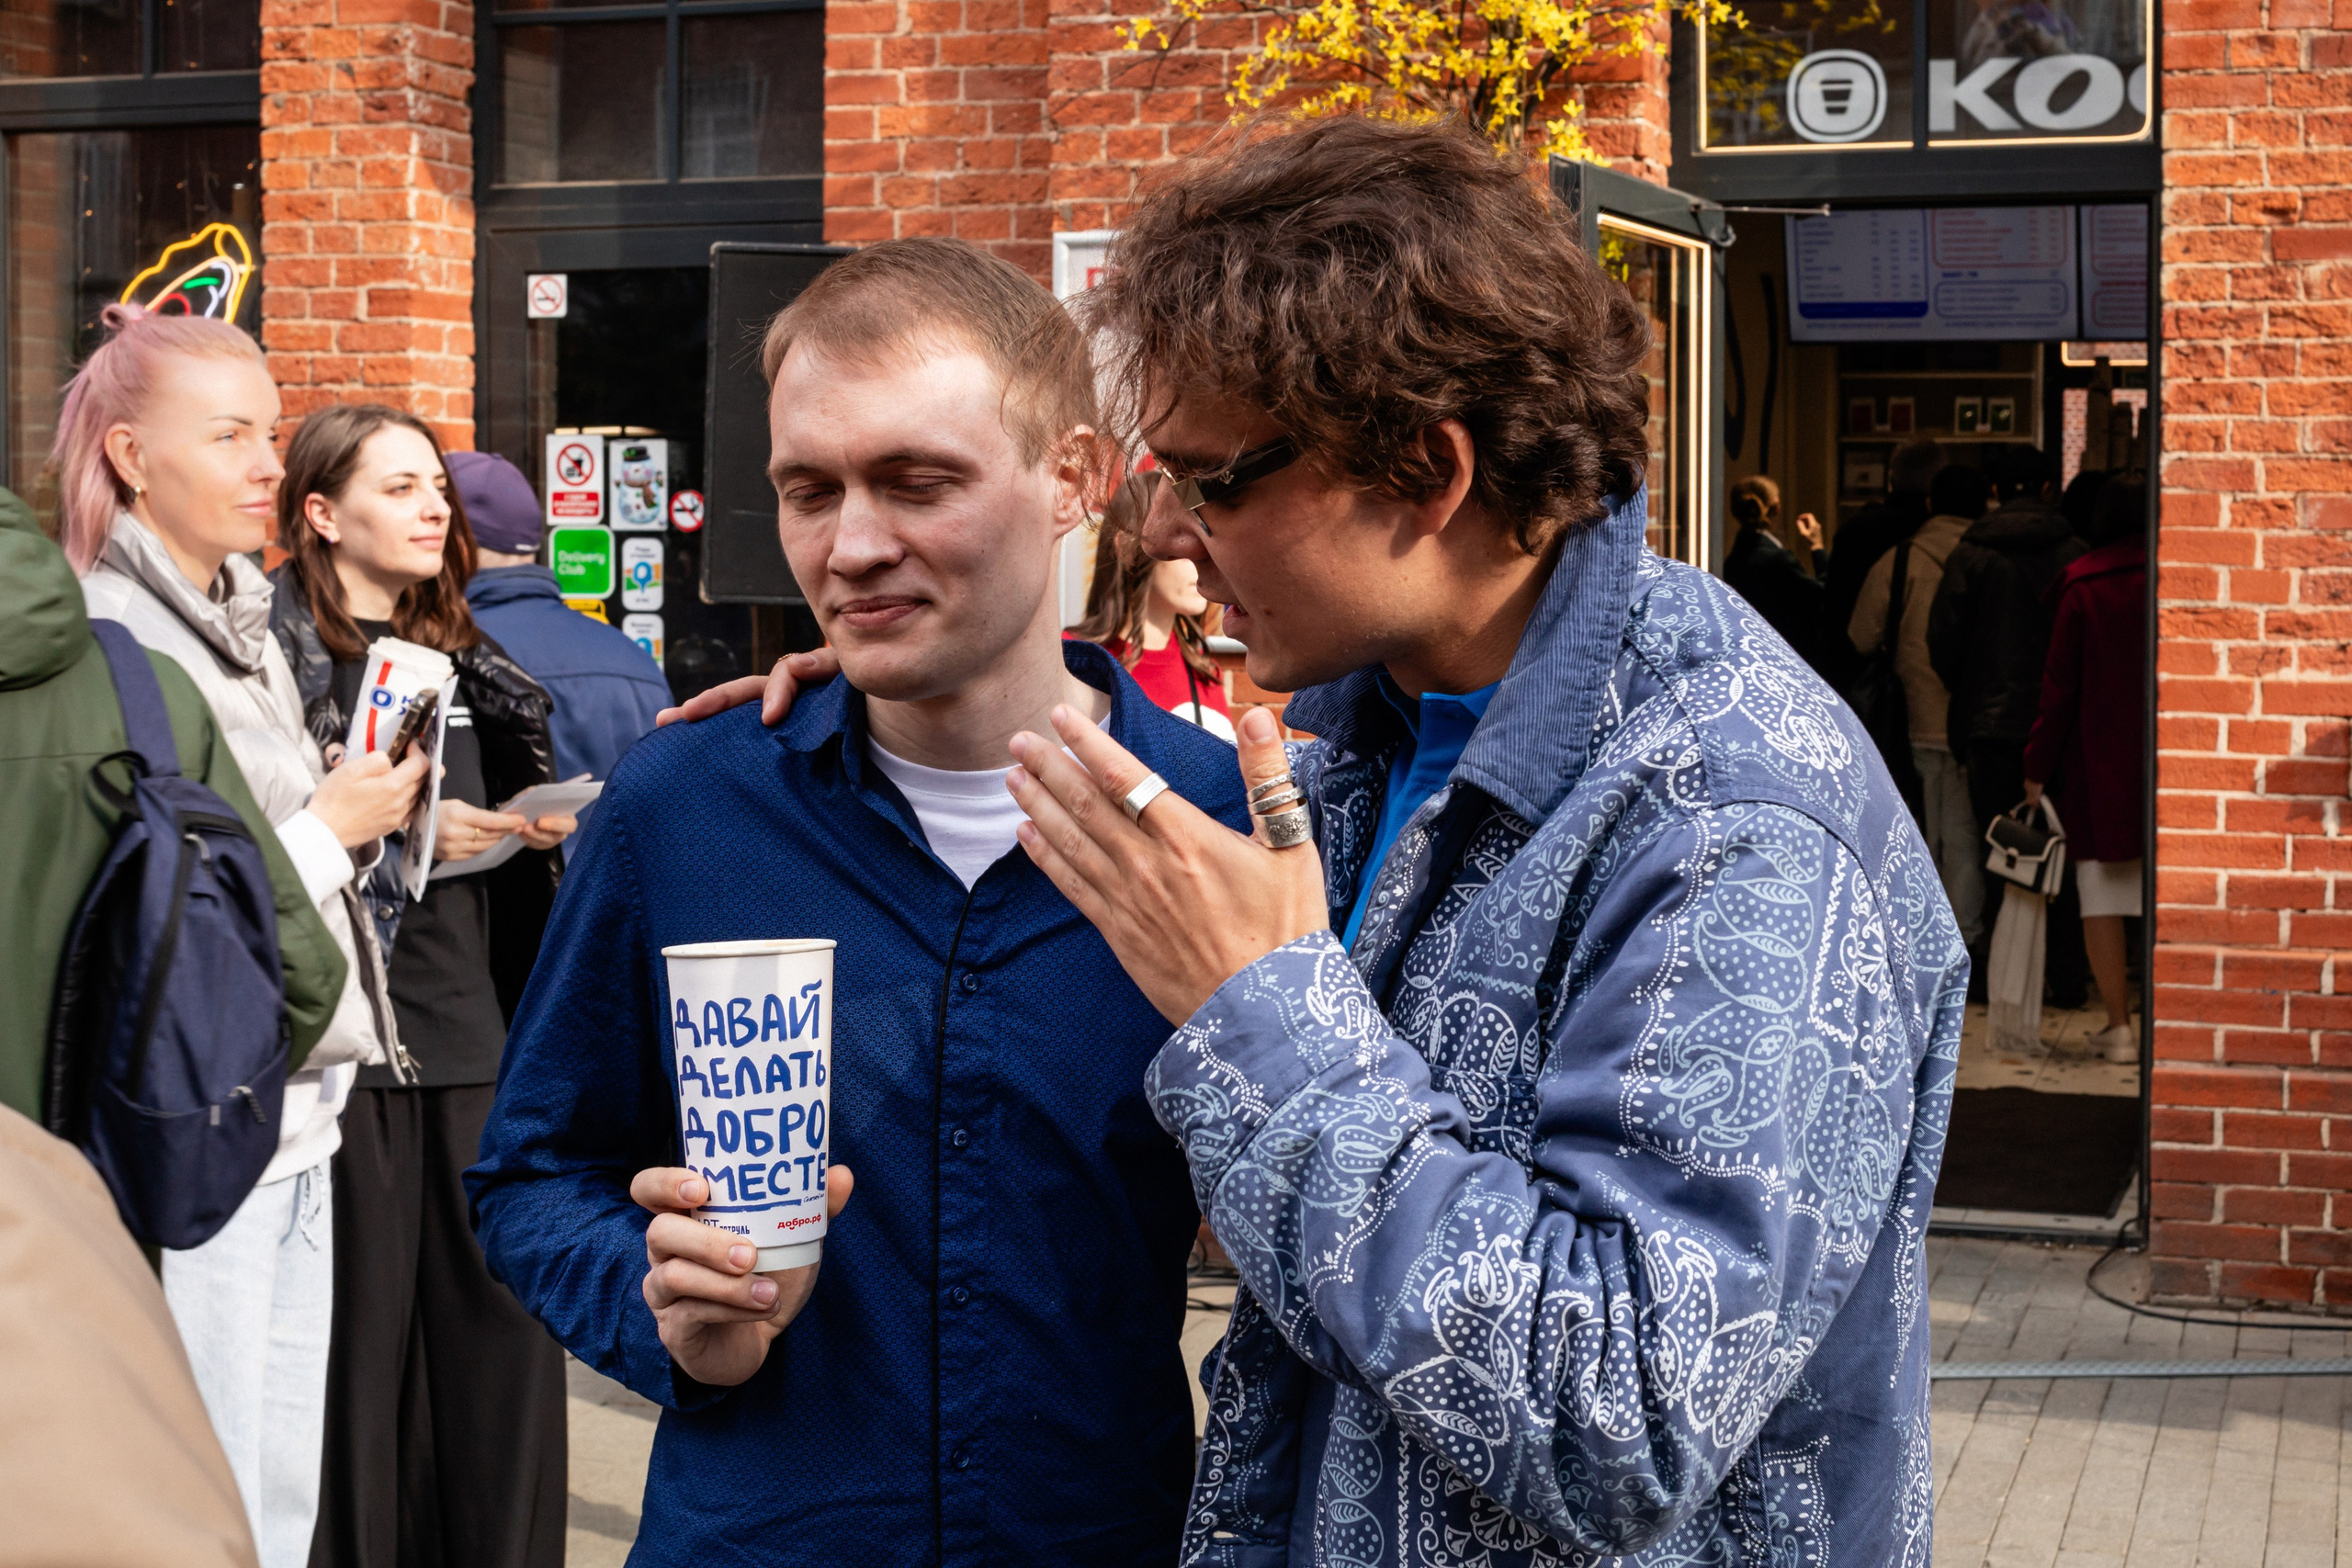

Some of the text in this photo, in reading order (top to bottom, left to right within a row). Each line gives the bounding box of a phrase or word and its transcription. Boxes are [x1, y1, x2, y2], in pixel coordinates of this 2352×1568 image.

[1929, 53, 2146, 131] КО
[675, 979, 822, 1050] ДАВАЙ
[681, 1050, 826, 1099] ДЕЛАТЬ
[684, 1100, 825, 1157] ДОБРО
[688, 1152, 826, 1202] МЕСТЕ
[777, 1213, 822, 1230] добро.рф
